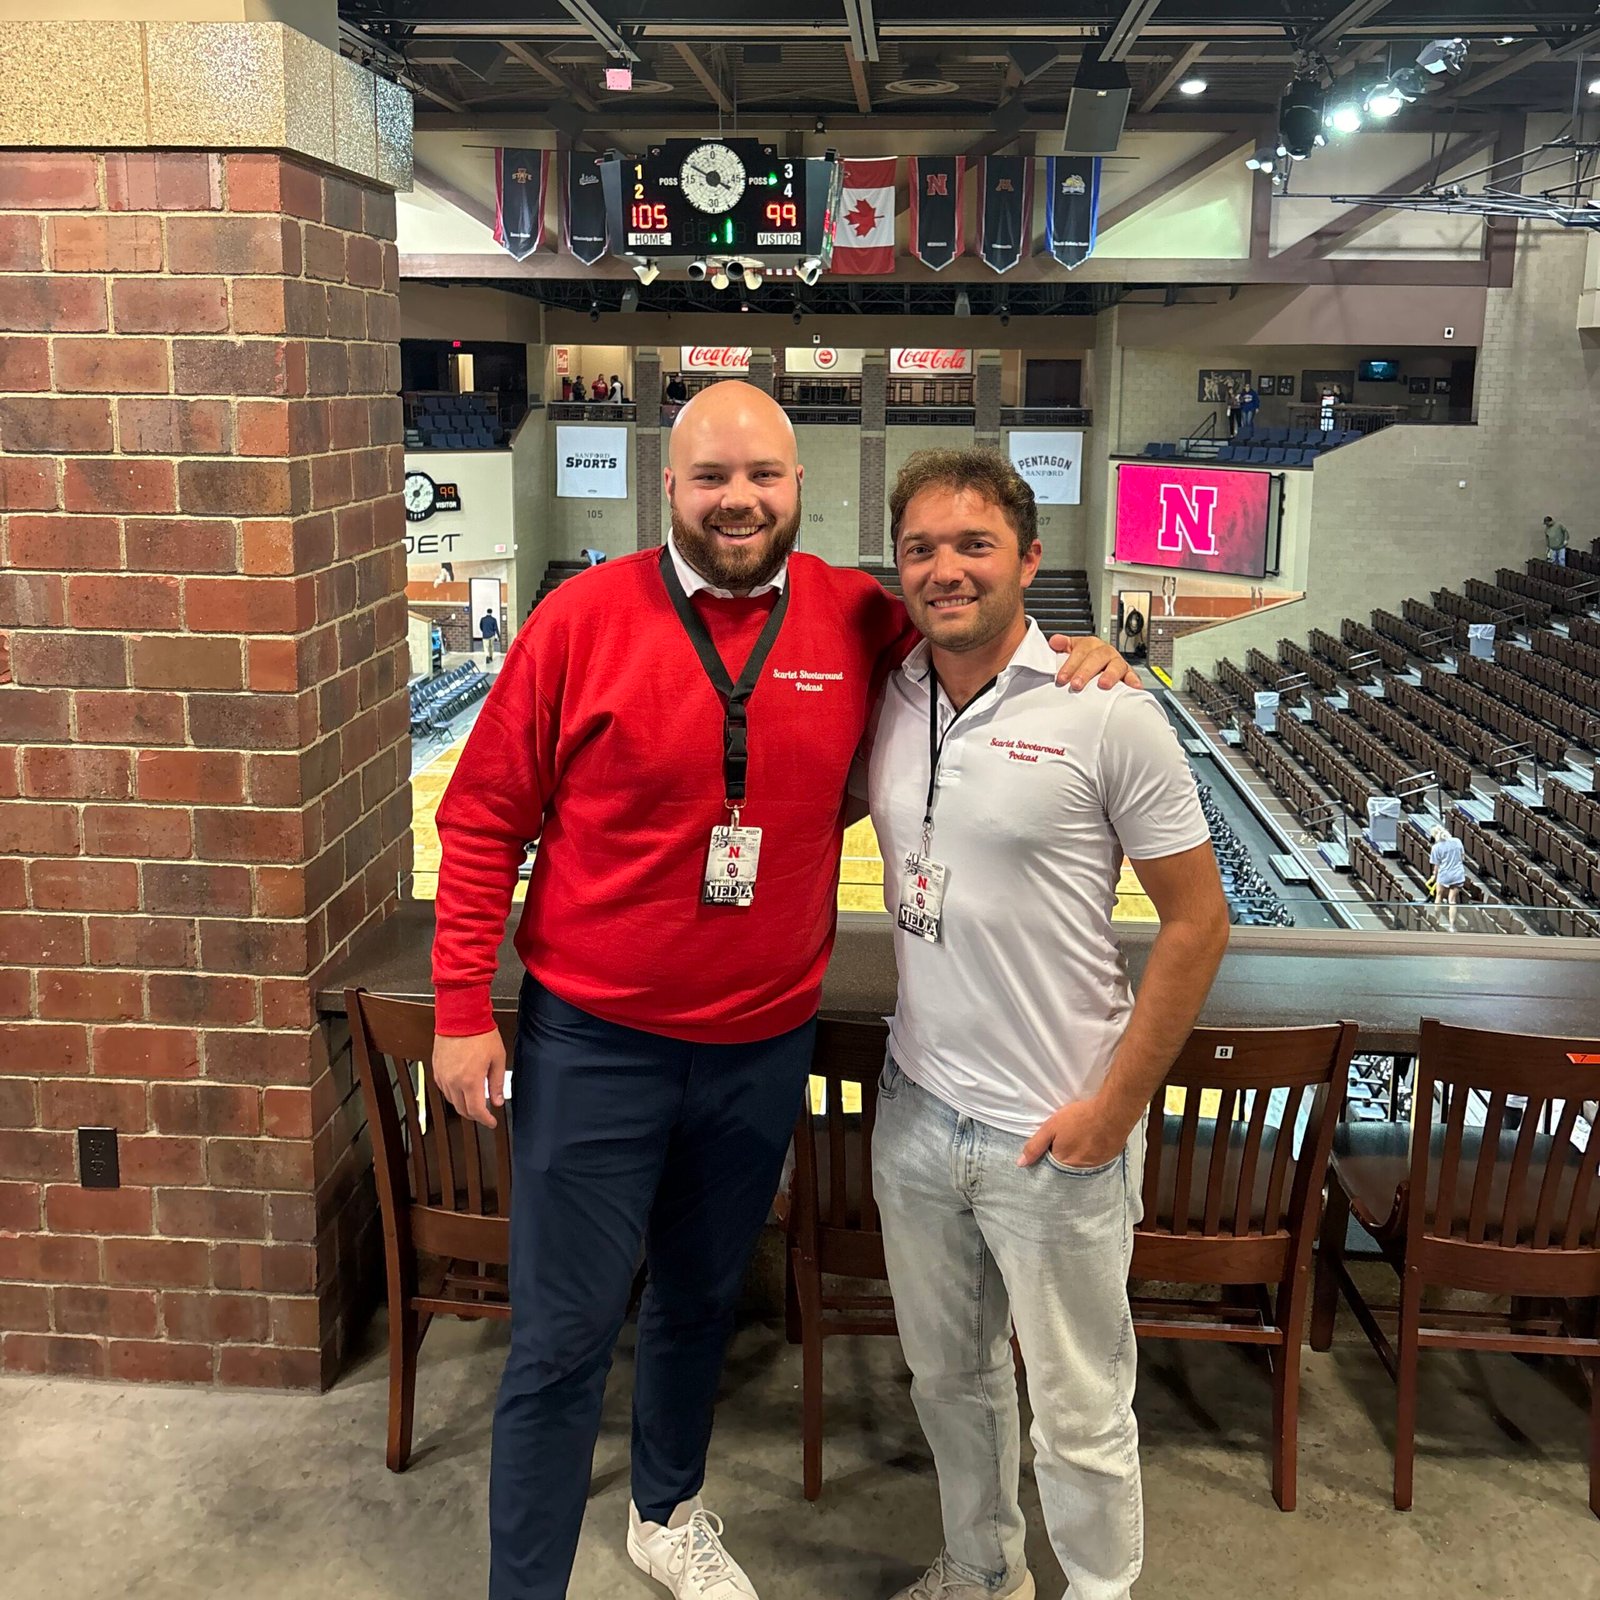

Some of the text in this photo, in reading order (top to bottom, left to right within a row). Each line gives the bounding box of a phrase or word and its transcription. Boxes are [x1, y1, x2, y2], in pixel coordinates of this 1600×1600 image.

[634, 164, 642, 180] 1
[784, 163, 794, 179] 3
[658, 177, 679, 186] POSS
[748, 176, 768, 186] POSS
[926, 174, 948, 196] N
[634, 183, 644, 200] 2
[783, 183, 793, 198] 4
[632, 204, 668, 229] 105
[766, 204, 797, 227] 99
[635, 234, 665, 245] HOME
[759, 234, 800, 245] VISITOR
[566, 456, 618, 469] SPORTS
[1018, 455, 1073, 471] PENTAGON
[1025, 469, 1065, 477] SANFORD
[439, 486, 455, 498] 99
[435, 501, 457, 509] VISITOR
[587, 509, 604, 519] 105
[808, 513, 824, 523] 106
[1157, 483, 1218, 556] N
[1037, 516, 1051, 526] 07
[772, 668, 844, 680] Scarlet Shootaround
[795, 681, 823, 692] Podcast
[990, 737, 1066, 757] Scarlet Shootaround
[1008, 750, 1038, 763] Podcast
[728, 846, 741, 859] N
[917, 875, 928, 890] N
[704, 885, 754, 898] MEDIA
[1219, 1047, 1229, 1058] 8
